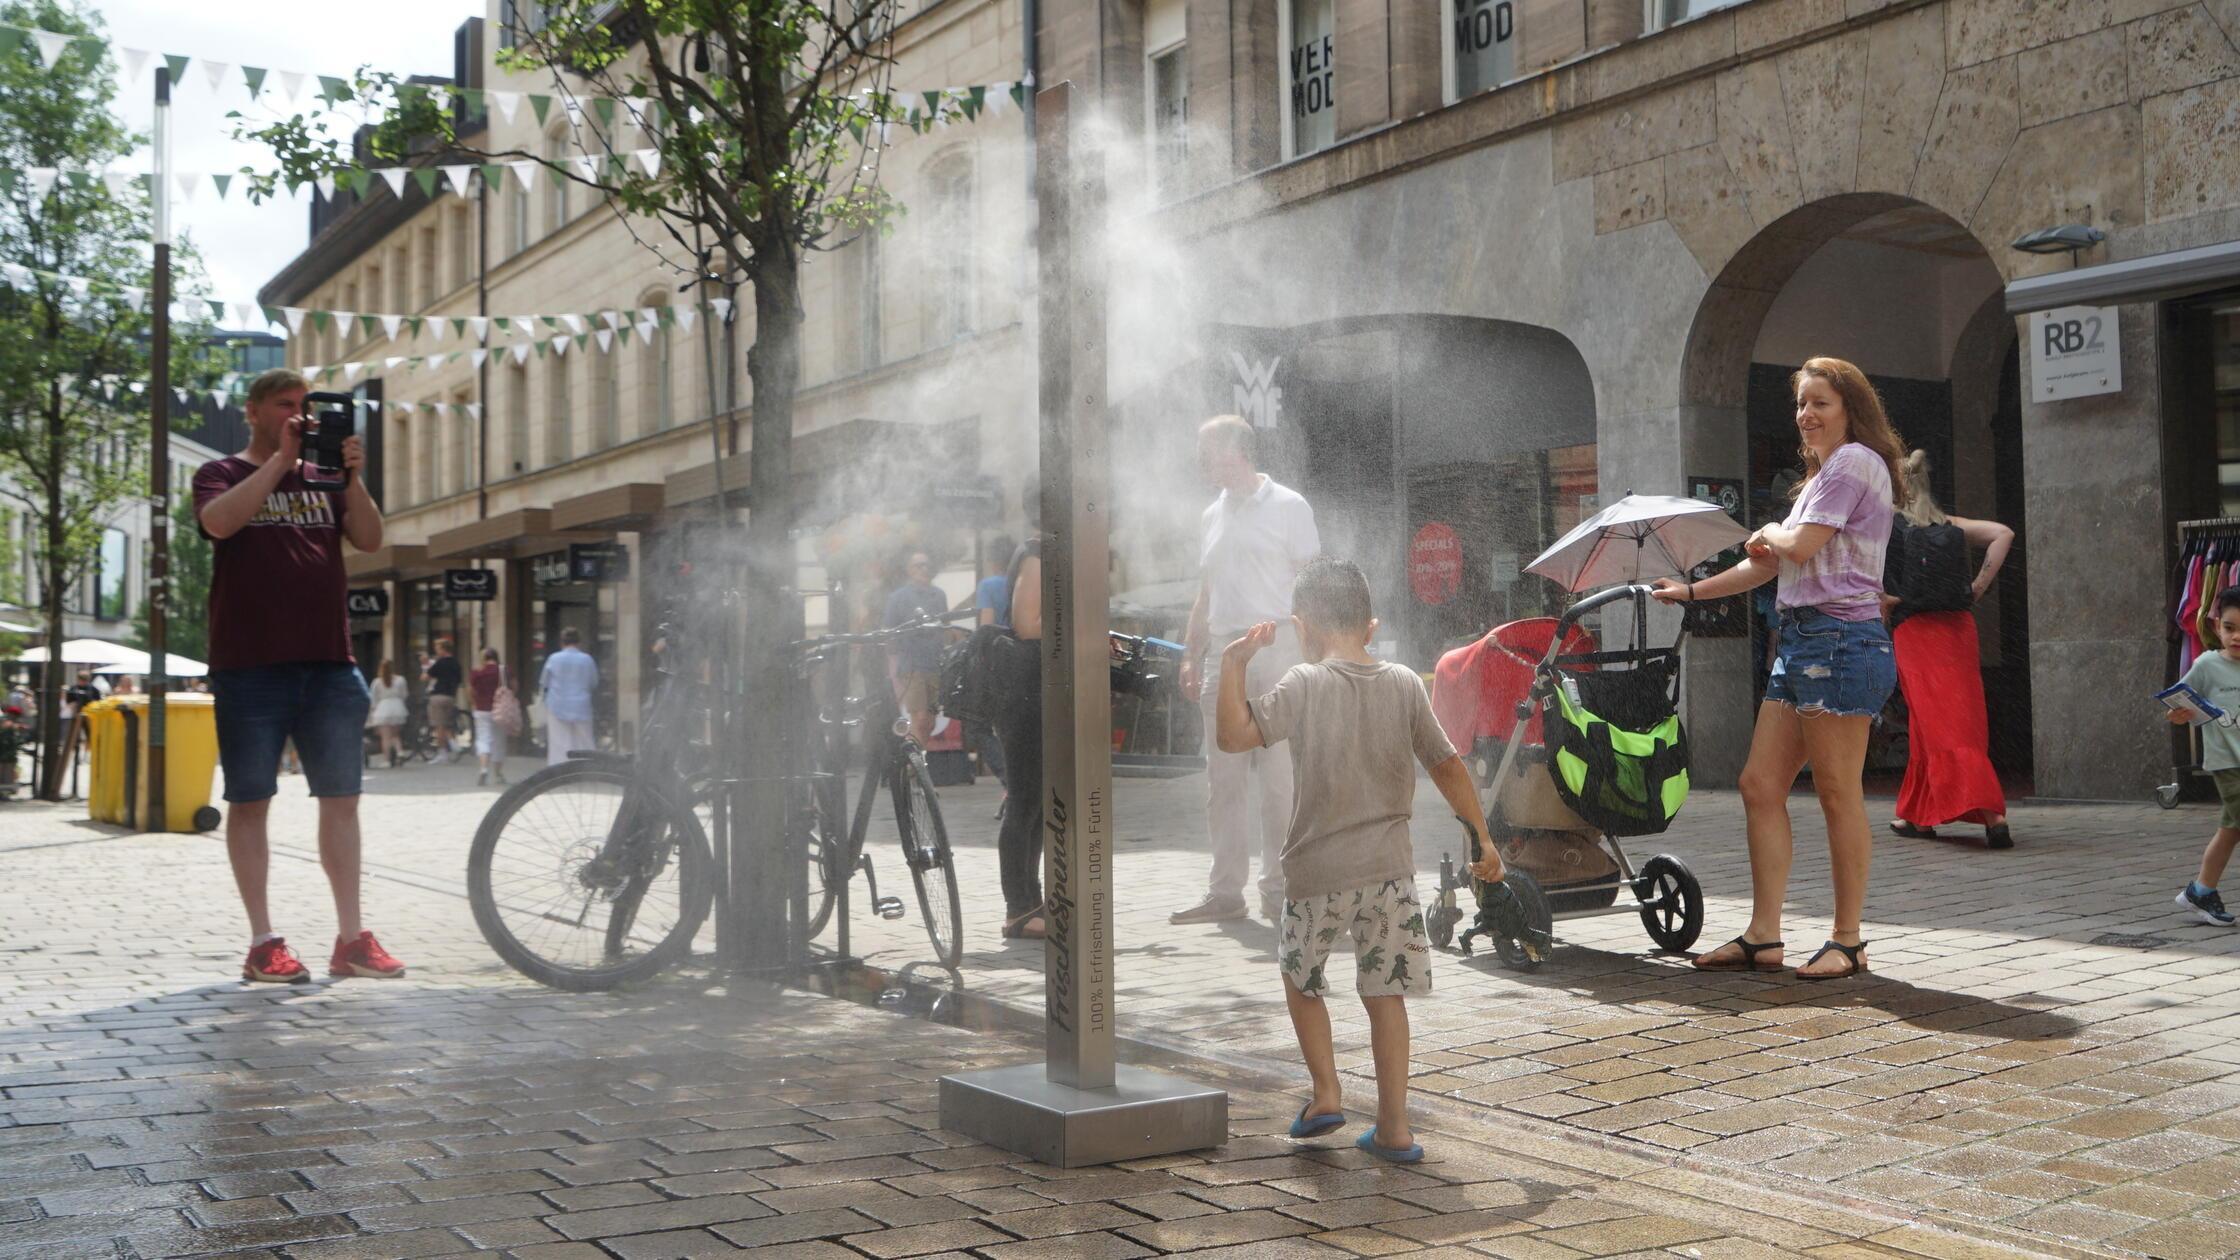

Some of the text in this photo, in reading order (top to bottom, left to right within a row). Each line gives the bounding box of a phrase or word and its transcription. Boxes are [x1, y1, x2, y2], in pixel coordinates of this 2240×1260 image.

[1456, 1, 1513, 53] MOD
[2044, 316, 2105, 356] RB2
[1231, 351, 1282, 428] WMF
[1088, 786, 1105, 1033] 100% Erfrischung. 100% Fürth.
